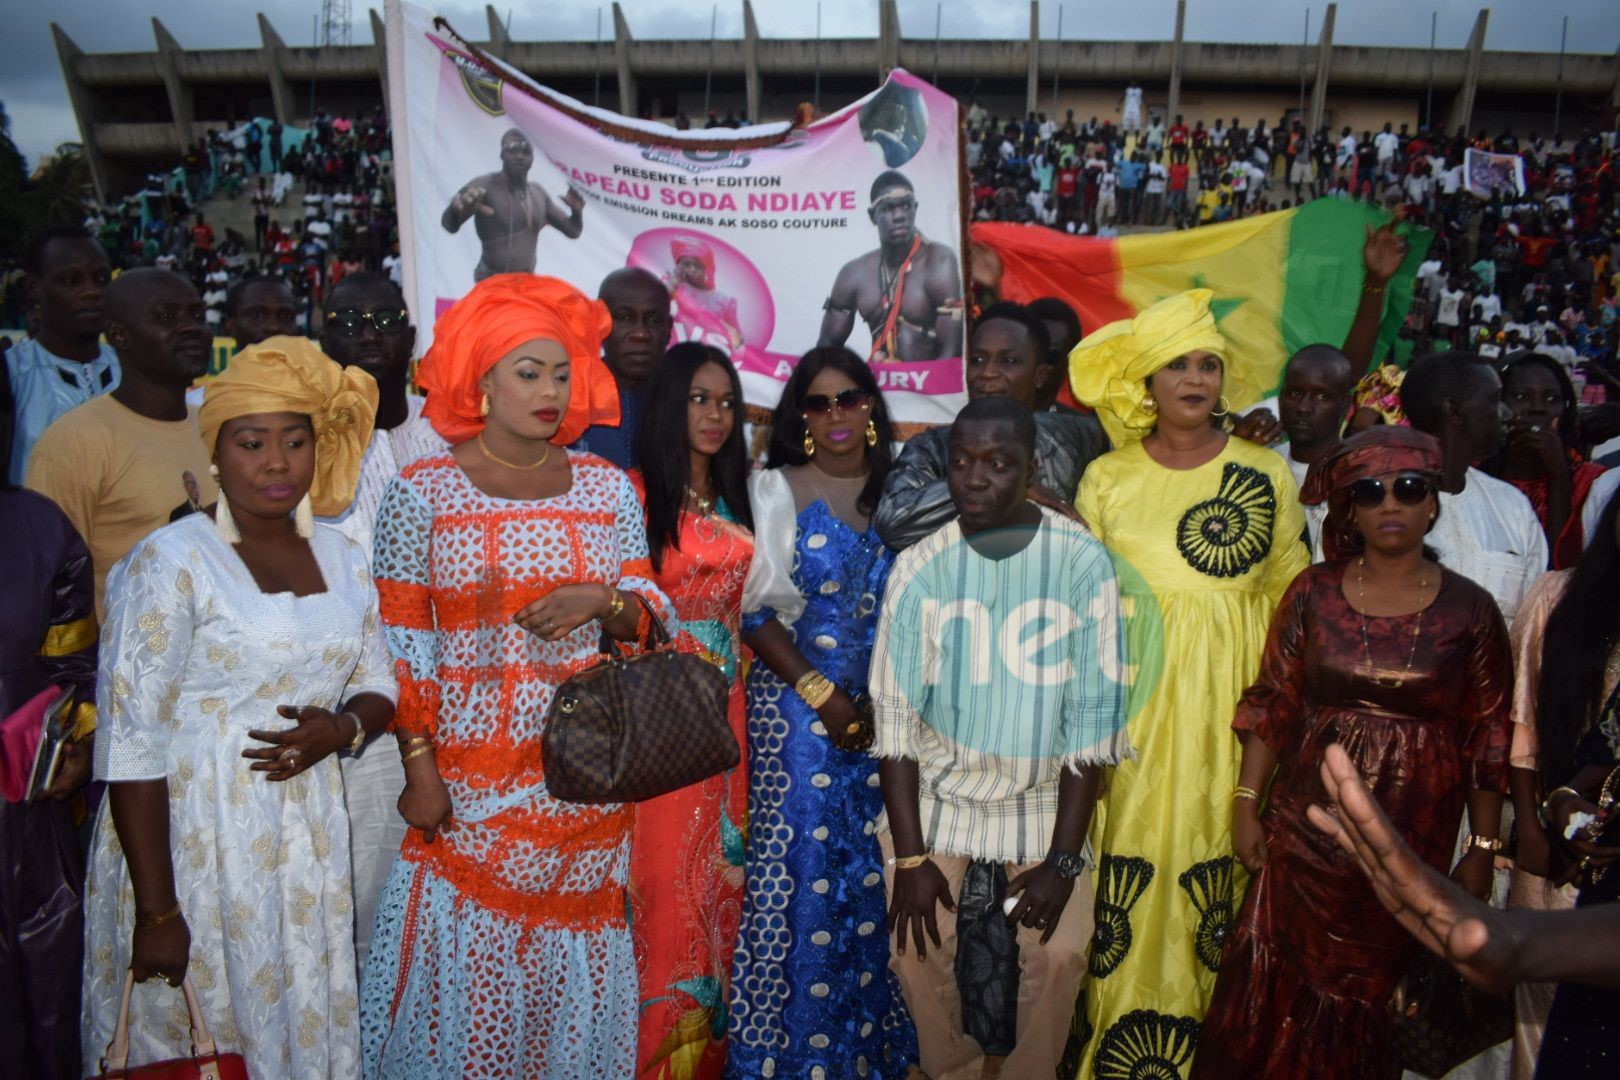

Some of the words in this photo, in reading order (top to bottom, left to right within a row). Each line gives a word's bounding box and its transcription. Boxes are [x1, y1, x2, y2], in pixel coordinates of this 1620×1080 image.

[553, 160, 652, 201] RAPEAU
[660, 187, 737, 211] SODA
[748, 190, 856, 212] NDIAYE
[613, 164, 687, 186] PRESENTE
[716, 176, 781, 188] EDITION
[604, 196, 659, 217] EMISSION
[661, 210, 714, 226] DREAMS
[718, 218, 737, 228] AK
[741, 219, 779, 229] SOSO
[782, 217, 848, 229] COUTURE
